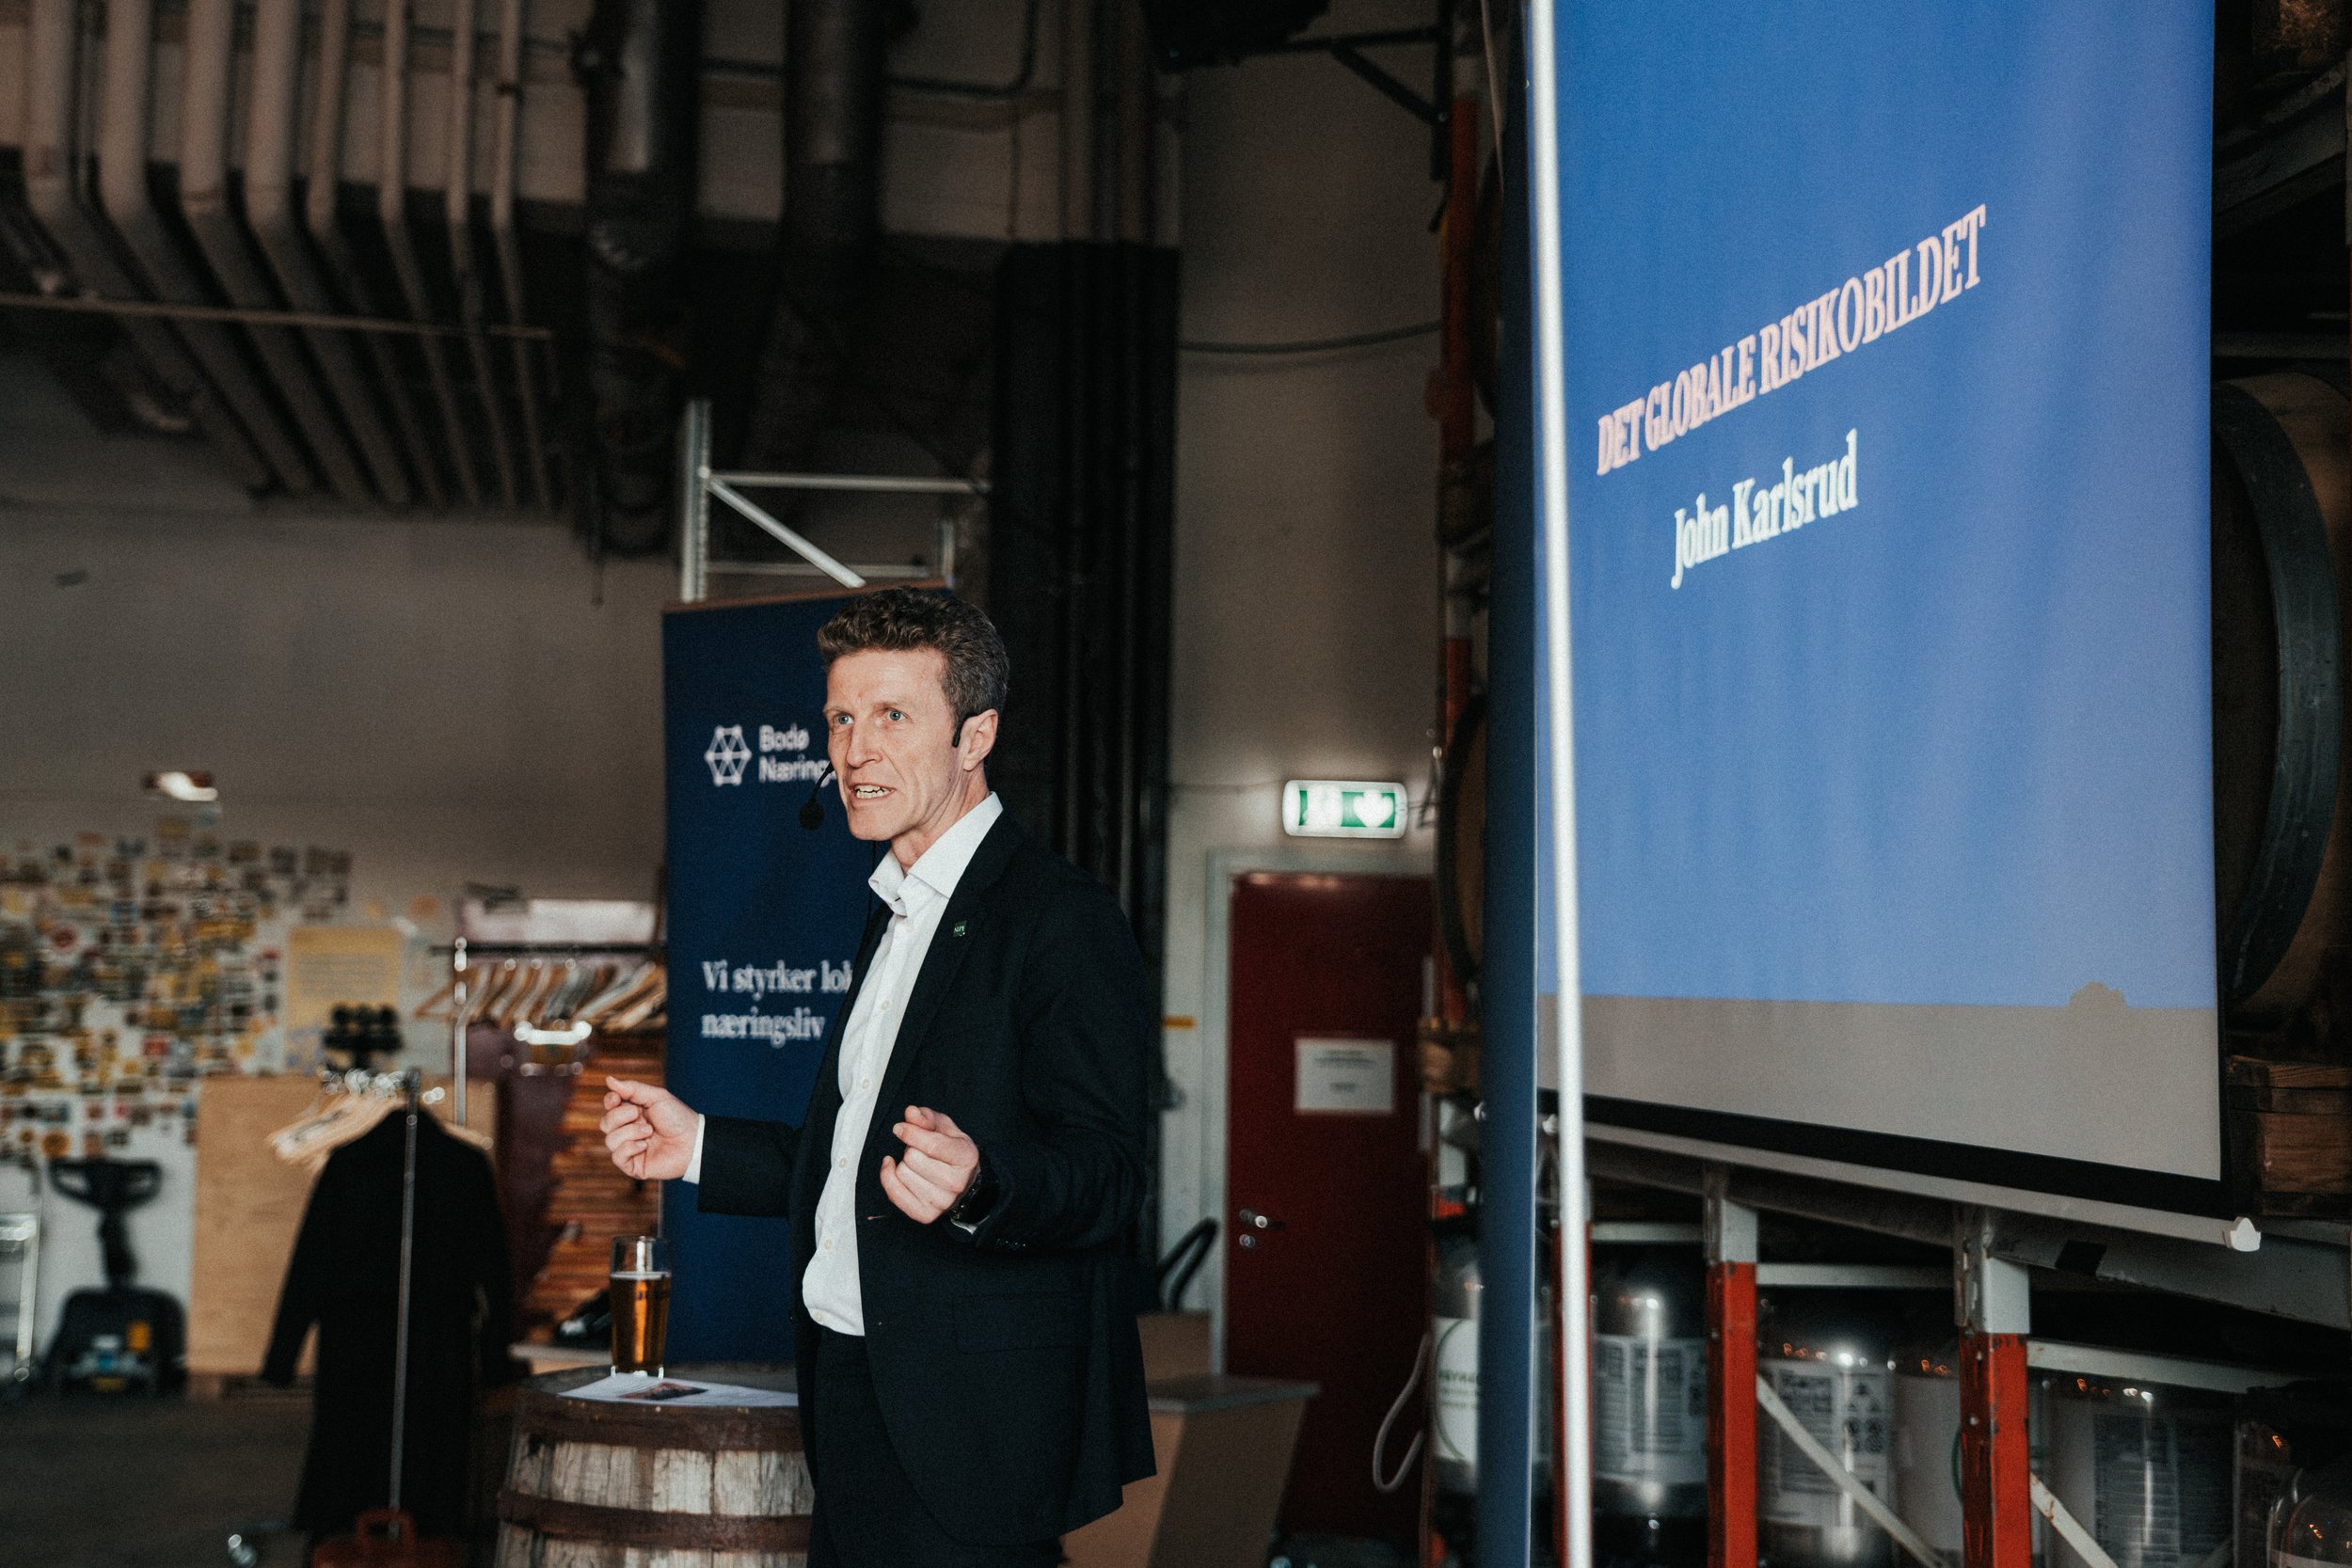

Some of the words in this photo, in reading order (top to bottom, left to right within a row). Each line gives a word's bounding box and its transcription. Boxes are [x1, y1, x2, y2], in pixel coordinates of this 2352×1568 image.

[1597, 397, 1645, 475] DET
[1645, 334, 1756, 451] GLOBALE
[1758, 203, 1986, 395] RISIKOBILDET
[1671, 493, 1729, 590] John
[1732, 429, 1858, 549] Karlsrud
[759, 723, 810, 752] Bodø
[702, 959, 728, 992] Vi
[732, 959, 817, 1002] styrker
[702, 1006, 825, 1049] næringsliv
